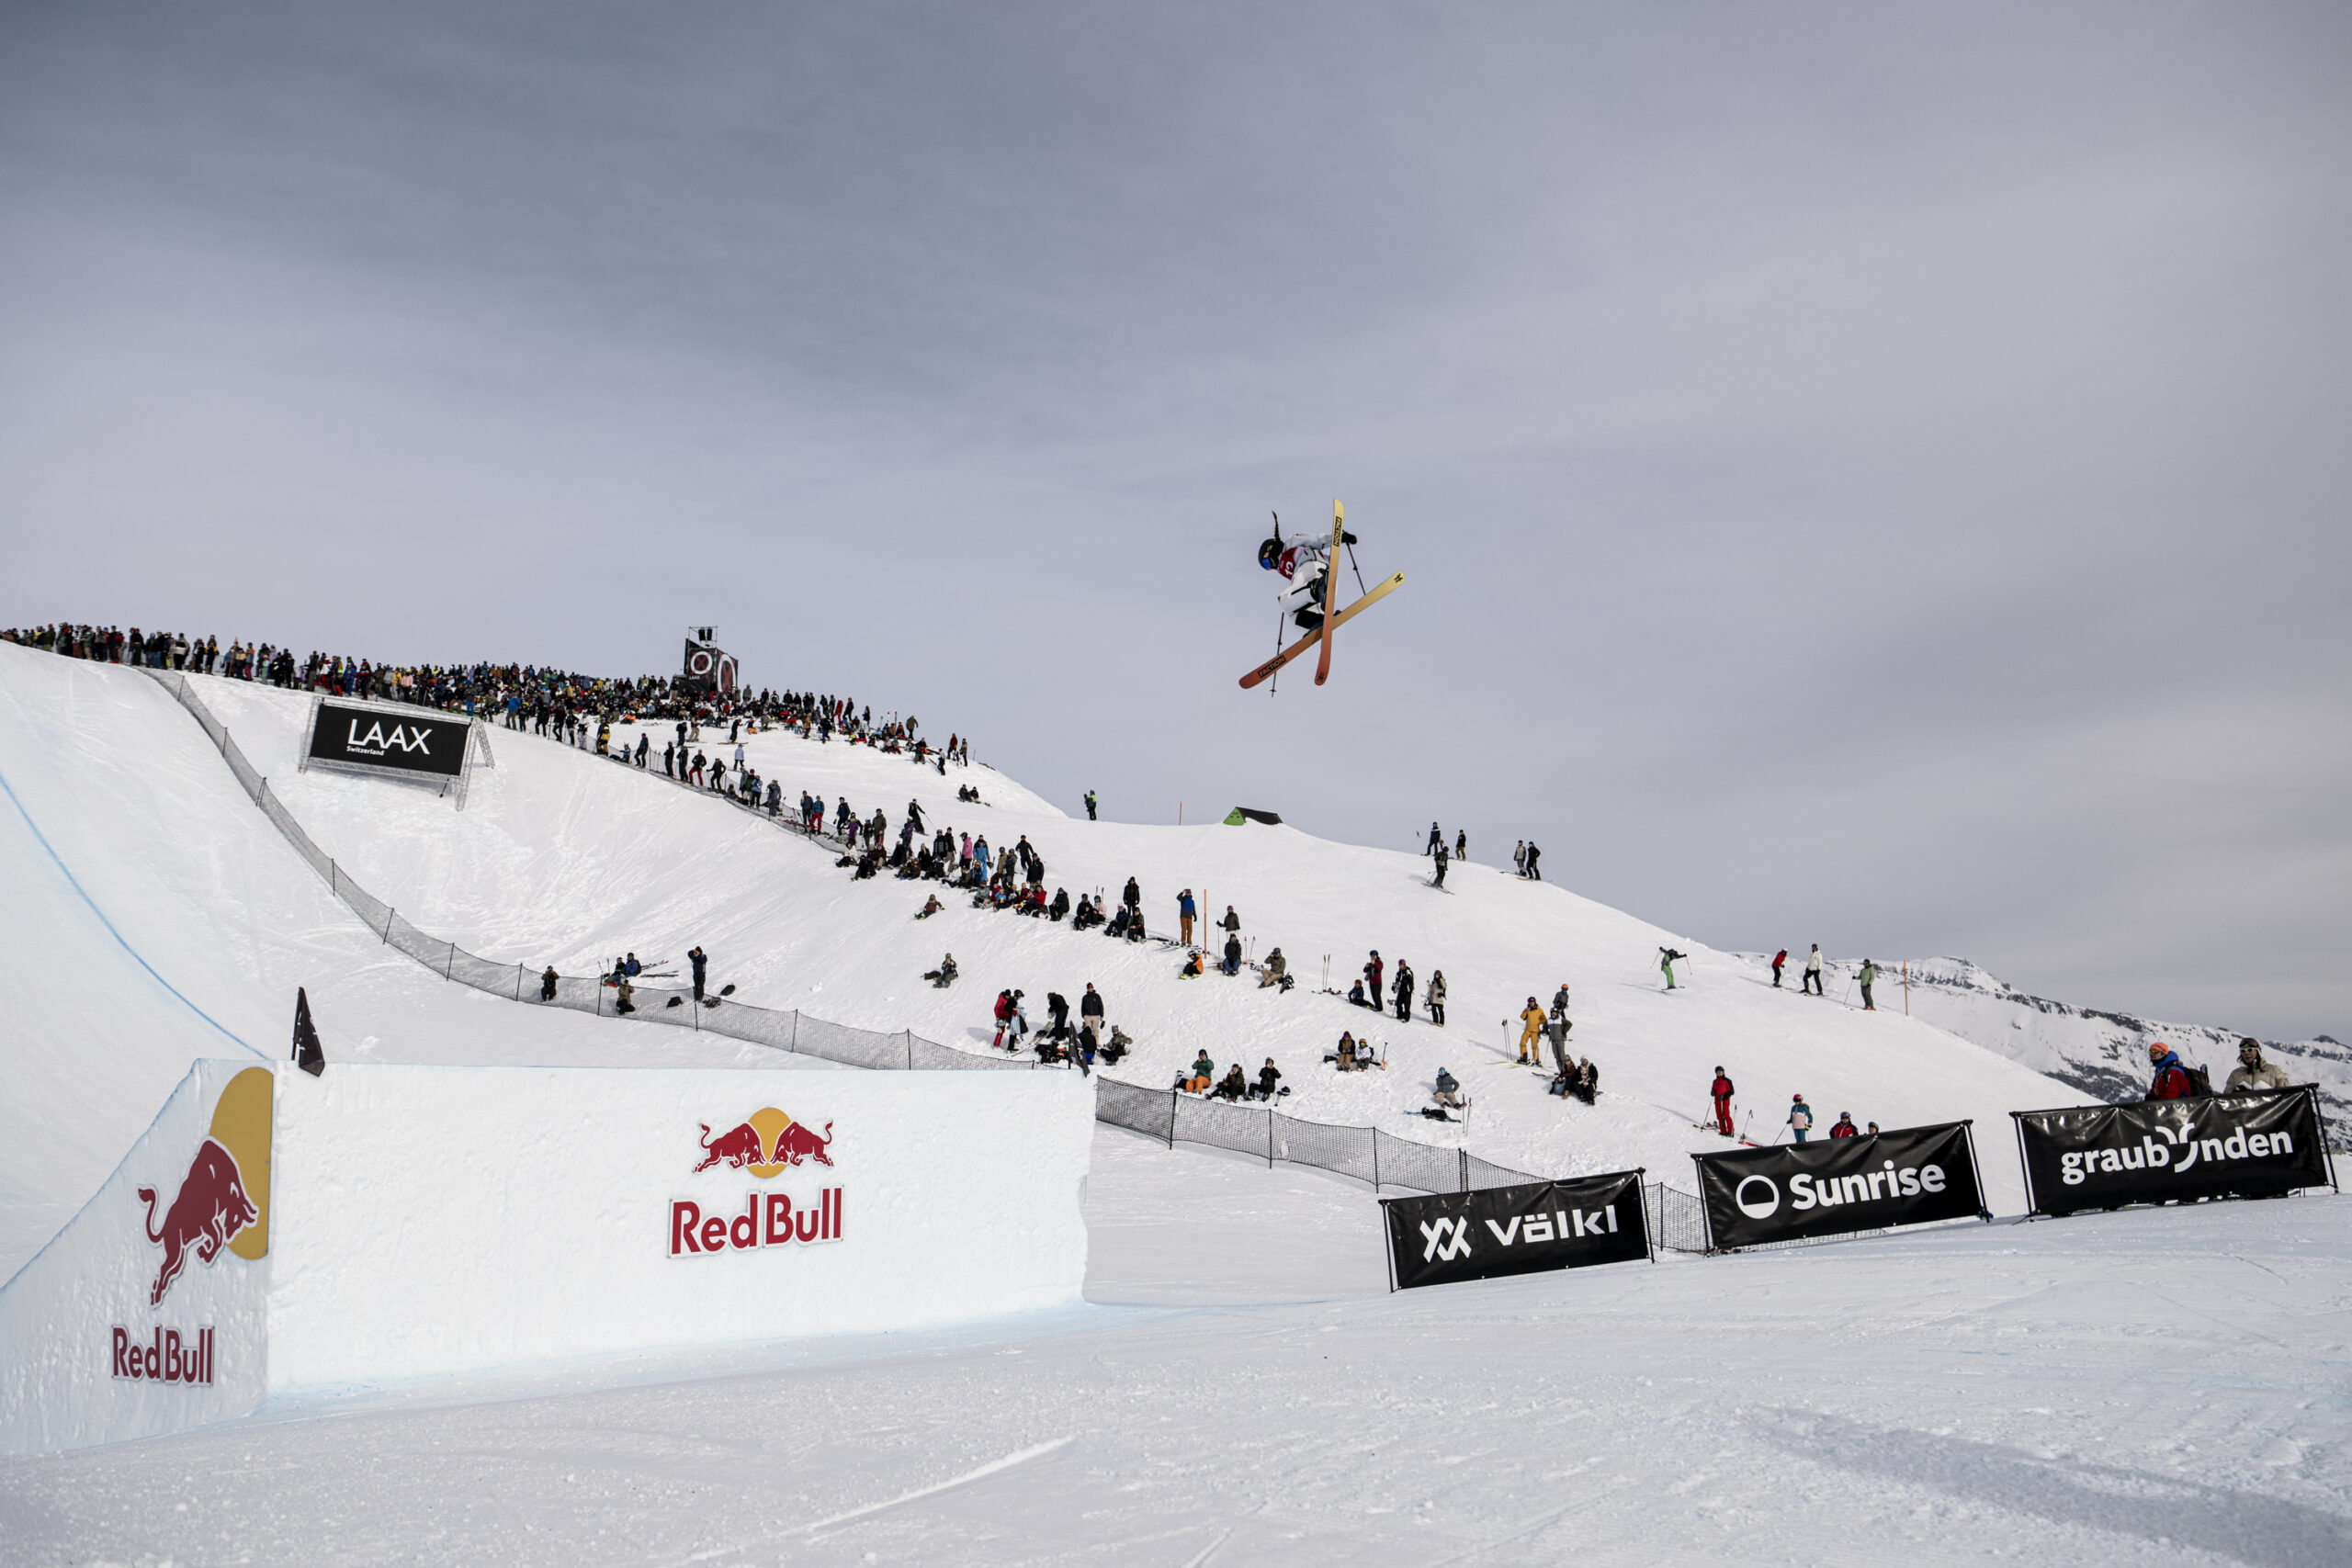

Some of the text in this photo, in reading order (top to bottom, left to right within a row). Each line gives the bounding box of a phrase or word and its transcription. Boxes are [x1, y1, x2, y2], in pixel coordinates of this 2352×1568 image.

[1333, 516, 1341, 546] FACTION
[1259, 656, 1285, 677] FACTION
[346, 746, 384, 756] Switzerland
[348, 719, 433, 755] LAAX
[1790, 1160, 1946, 1210] Sunrise
[672, 1188, 842, 1255] Red Bull
[1485, 1205, 1618, 1246] Völkl
[113, 1326, 212, 1383] Red Bull
